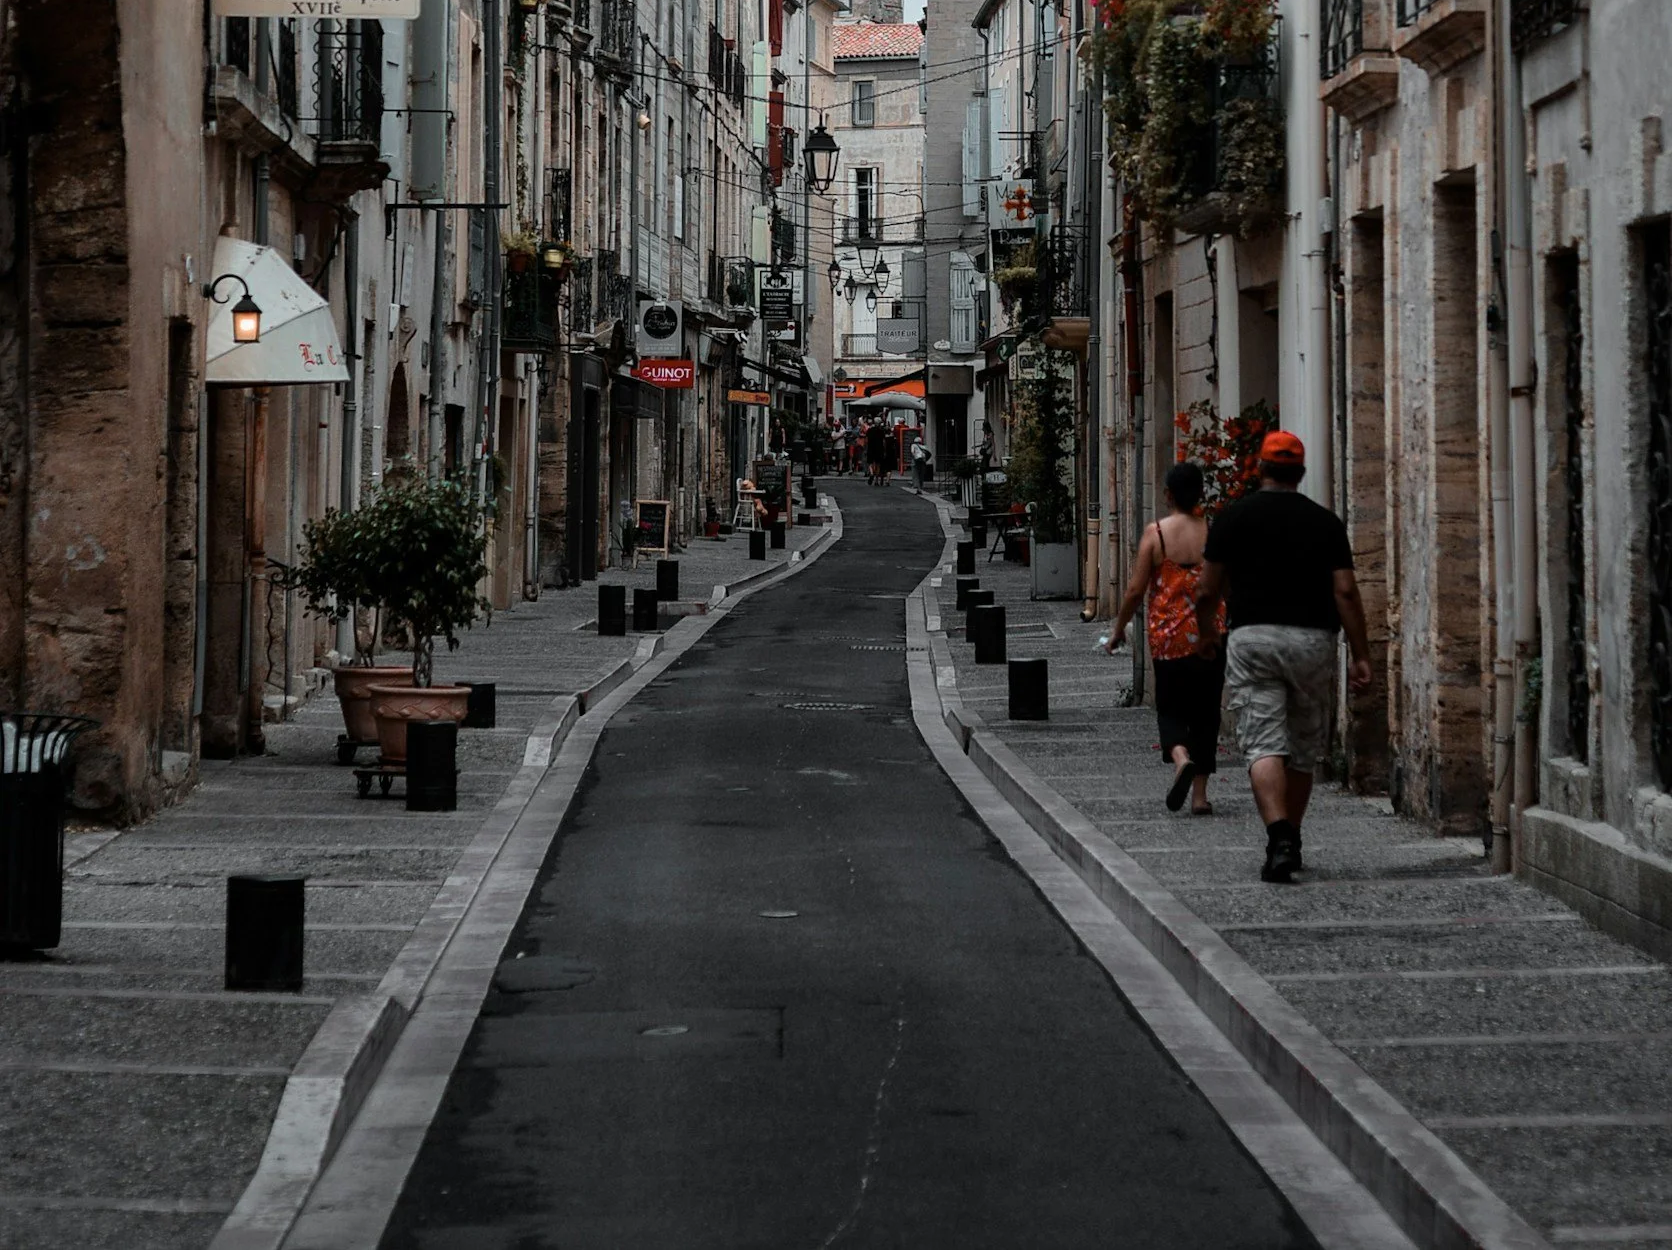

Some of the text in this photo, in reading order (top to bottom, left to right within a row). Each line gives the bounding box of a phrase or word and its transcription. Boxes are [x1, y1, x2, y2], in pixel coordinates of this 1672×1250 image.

[880, 330, 918, 338] TRAITEUR
[299, 343, 324, 372] La
[641, 366, 692, 378] GUINOT
